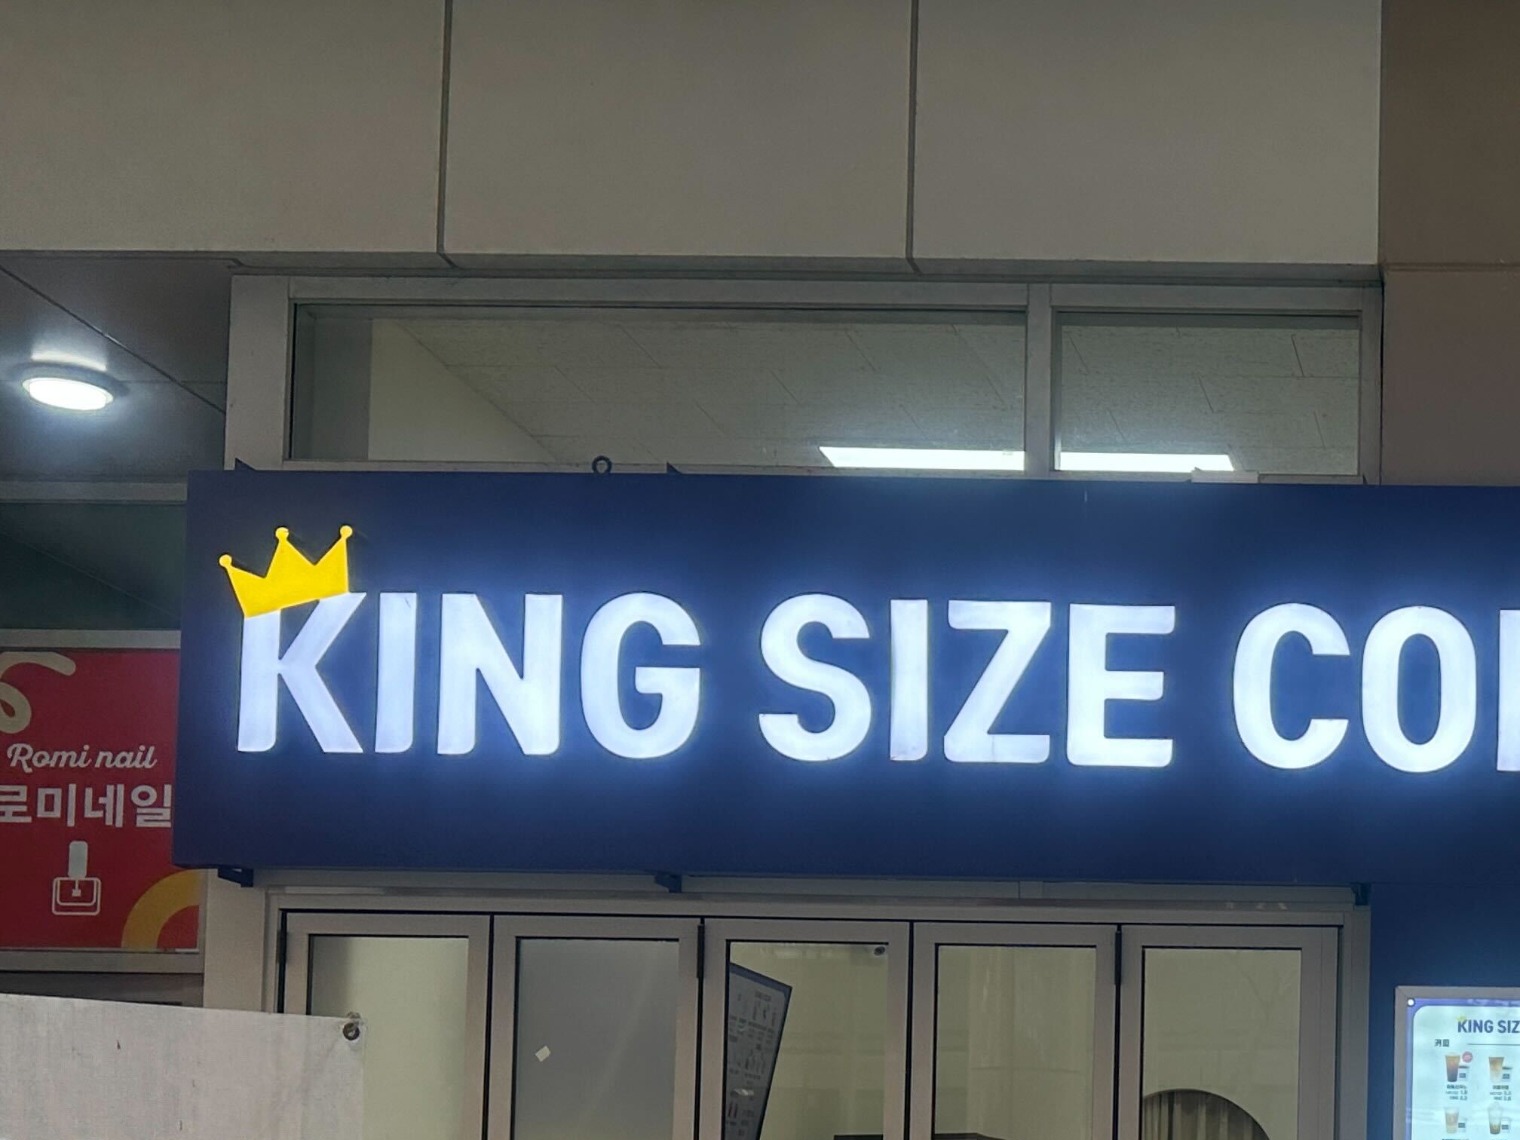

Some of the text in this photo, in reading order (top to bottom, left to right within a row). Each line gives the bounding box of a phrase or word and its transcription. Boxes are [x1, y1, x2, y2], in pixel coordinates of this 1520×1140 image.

[237, 592, 702, 758] KING
[758, 593, 1175, 766] SIZE
[7, 743, 157, 773] Romi nail
[0, 783, 172, 827] 로미네일
[1457, 1020, 1493, 1033] KING
